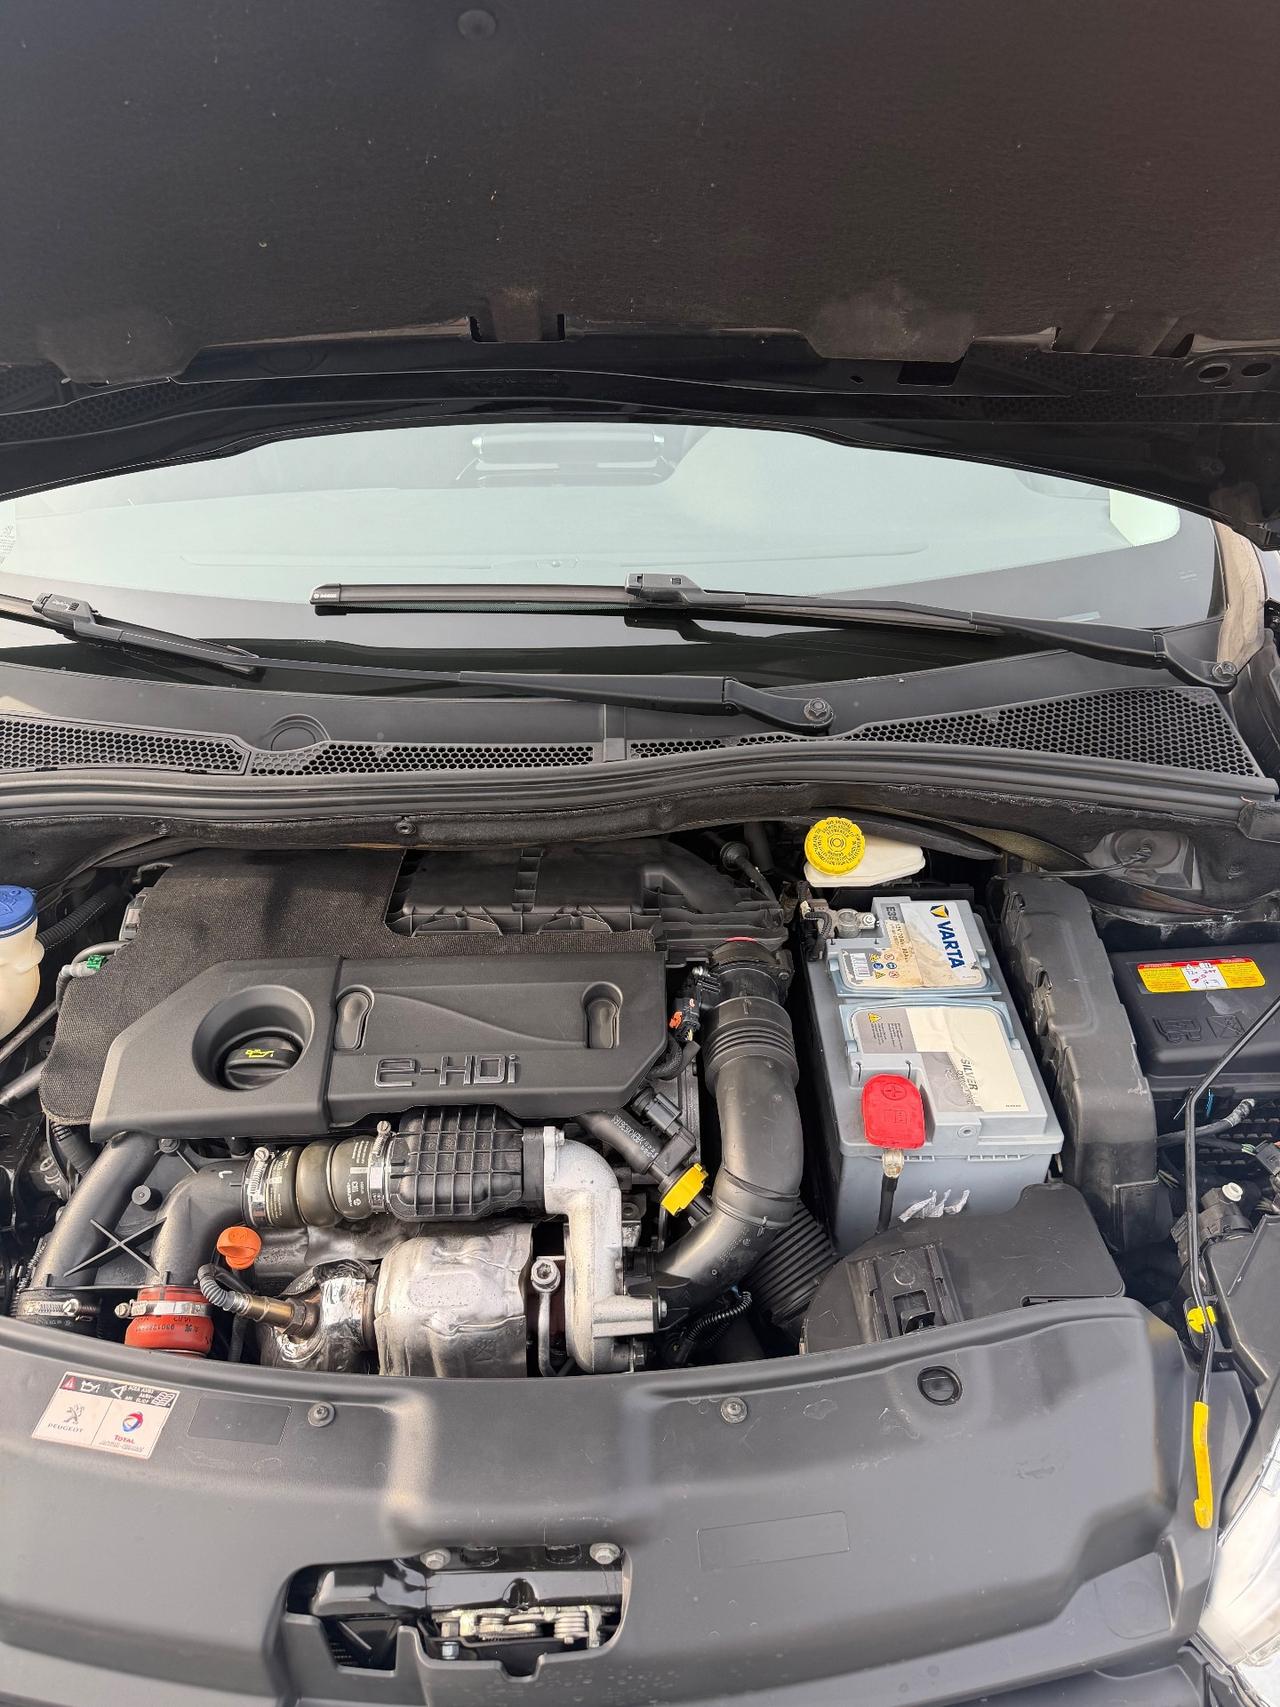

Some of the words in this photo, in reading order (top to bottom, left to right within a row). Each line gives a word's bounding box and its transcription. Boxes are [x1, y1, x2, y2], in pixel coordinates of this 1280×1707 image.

[886, 906, 898, 921] E39
[937, 920, 965, 968] VARTA
[375, 1054, 516, 1088] e-HDi
[961, 1058, 978, 1090] SILVER
[48, 1423, 84, 1433] PEUGEOT
[114, 1434, 135, 1444] TOTAL
